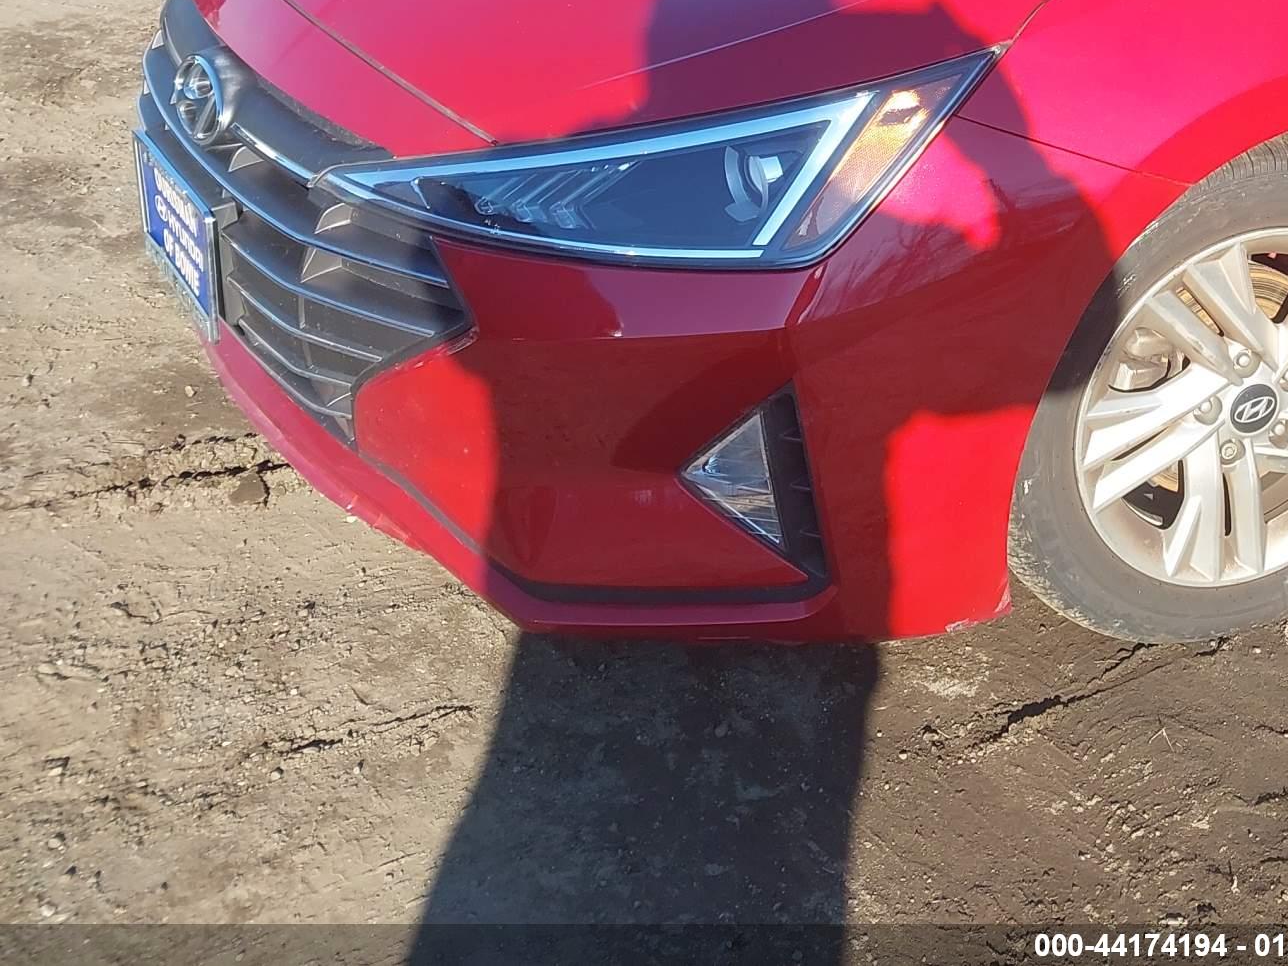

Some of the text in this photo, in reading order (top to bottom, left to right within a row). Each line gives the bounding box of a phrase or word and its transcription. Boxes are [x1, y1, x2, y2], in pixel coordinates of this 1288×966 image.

[163, 228, 200, 298] OF BOWIE
[167, 209, 204, 273] HYUNDAI
